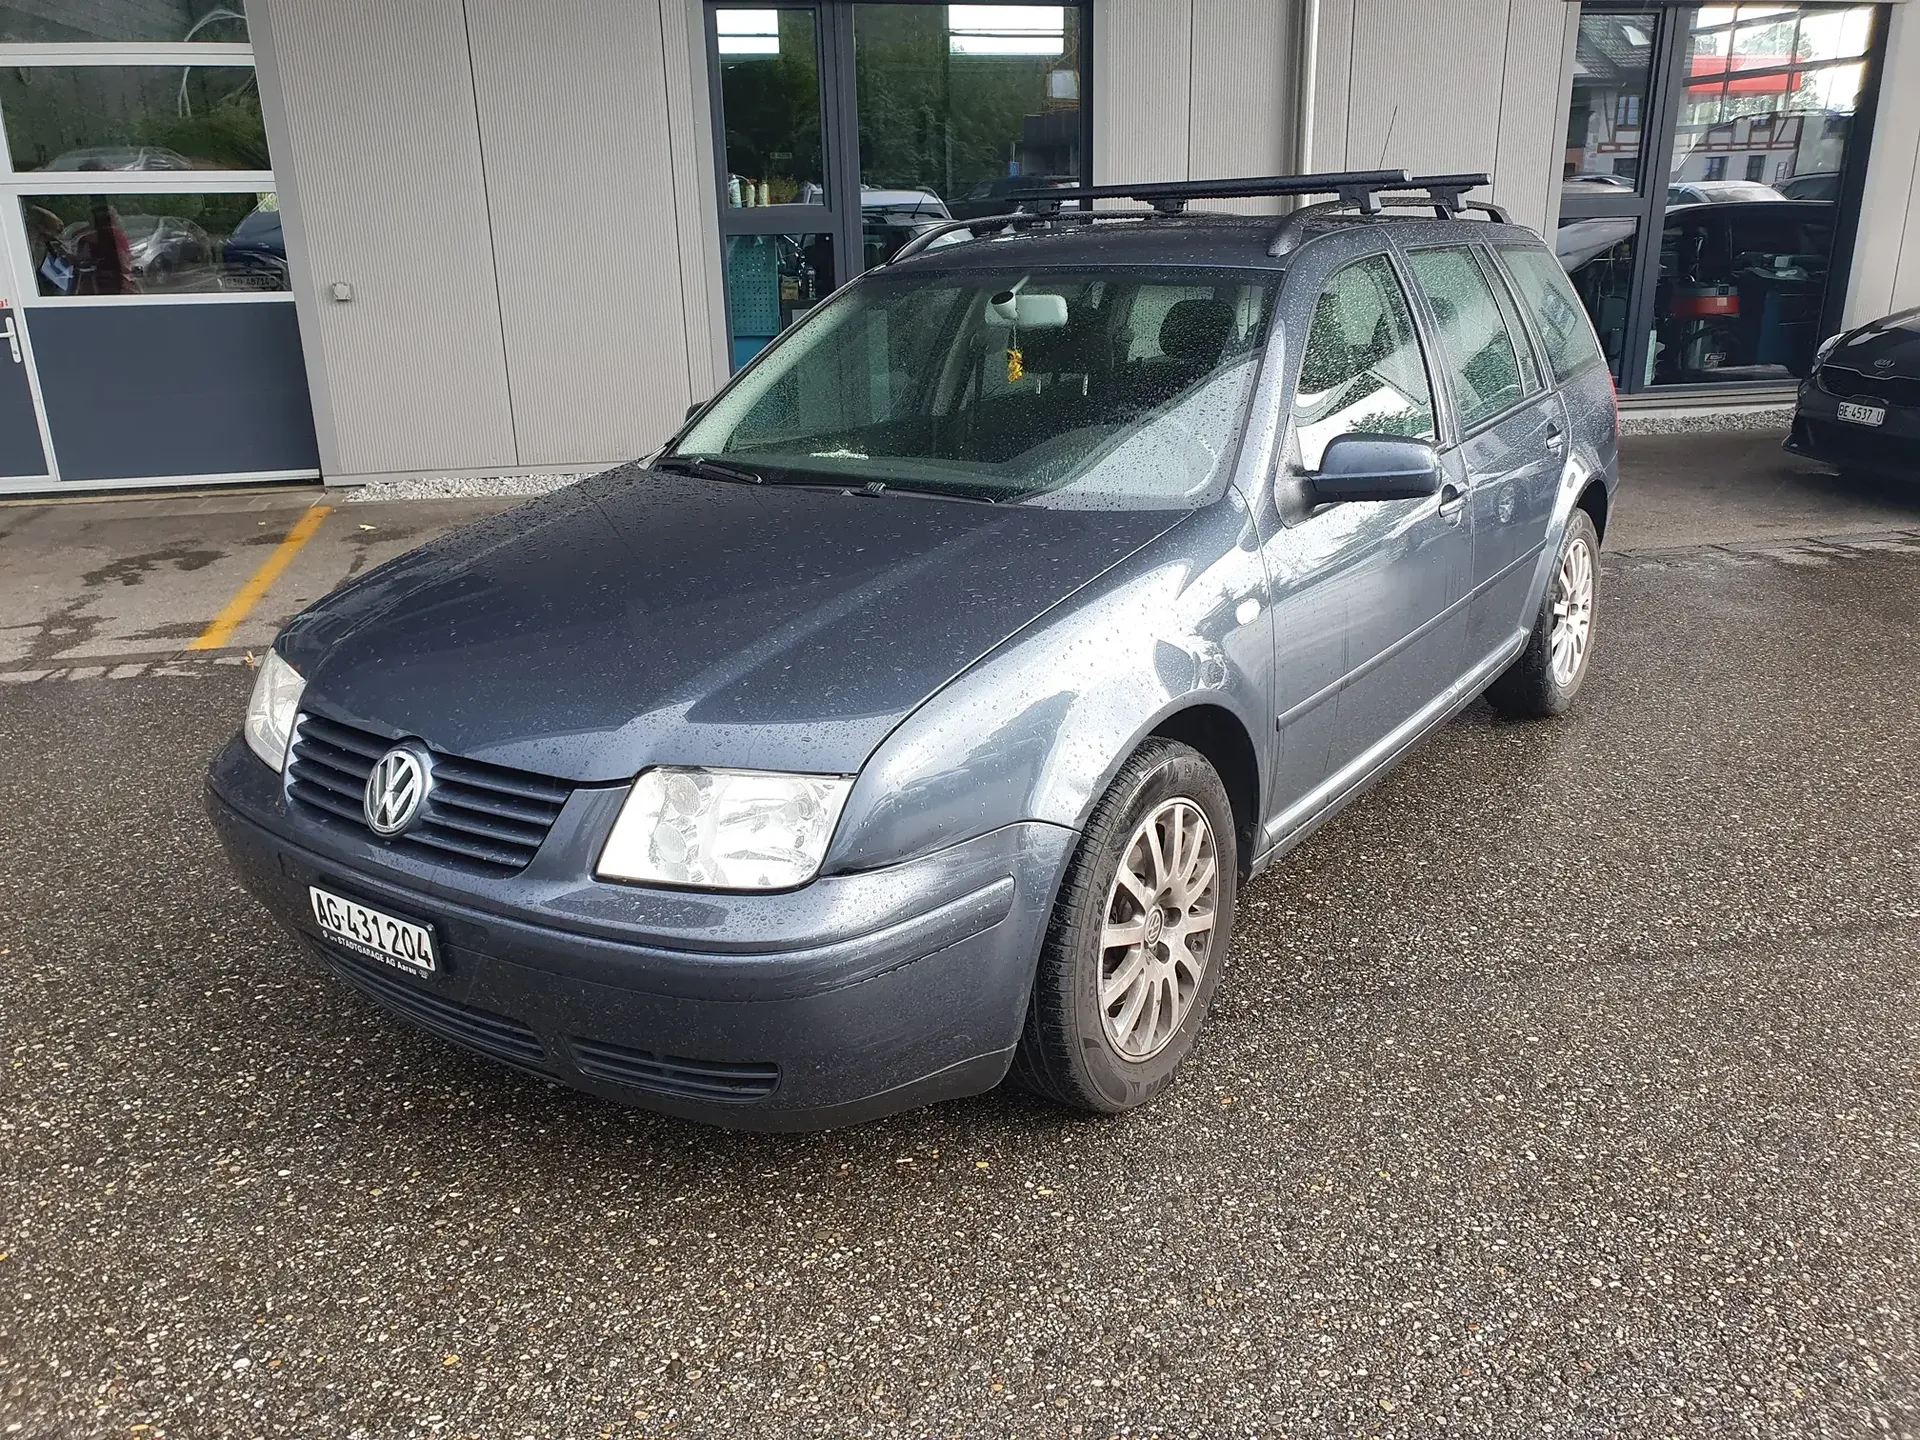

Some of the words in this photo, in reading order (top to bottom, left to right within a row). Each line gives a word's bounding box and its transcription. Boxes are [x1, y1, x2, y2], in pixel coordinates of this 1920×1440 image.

[1876, 411, 1883, 422] U
[337, 936, 385, 963] STADTGARAGE
[385, 956, 396, 967] AG
